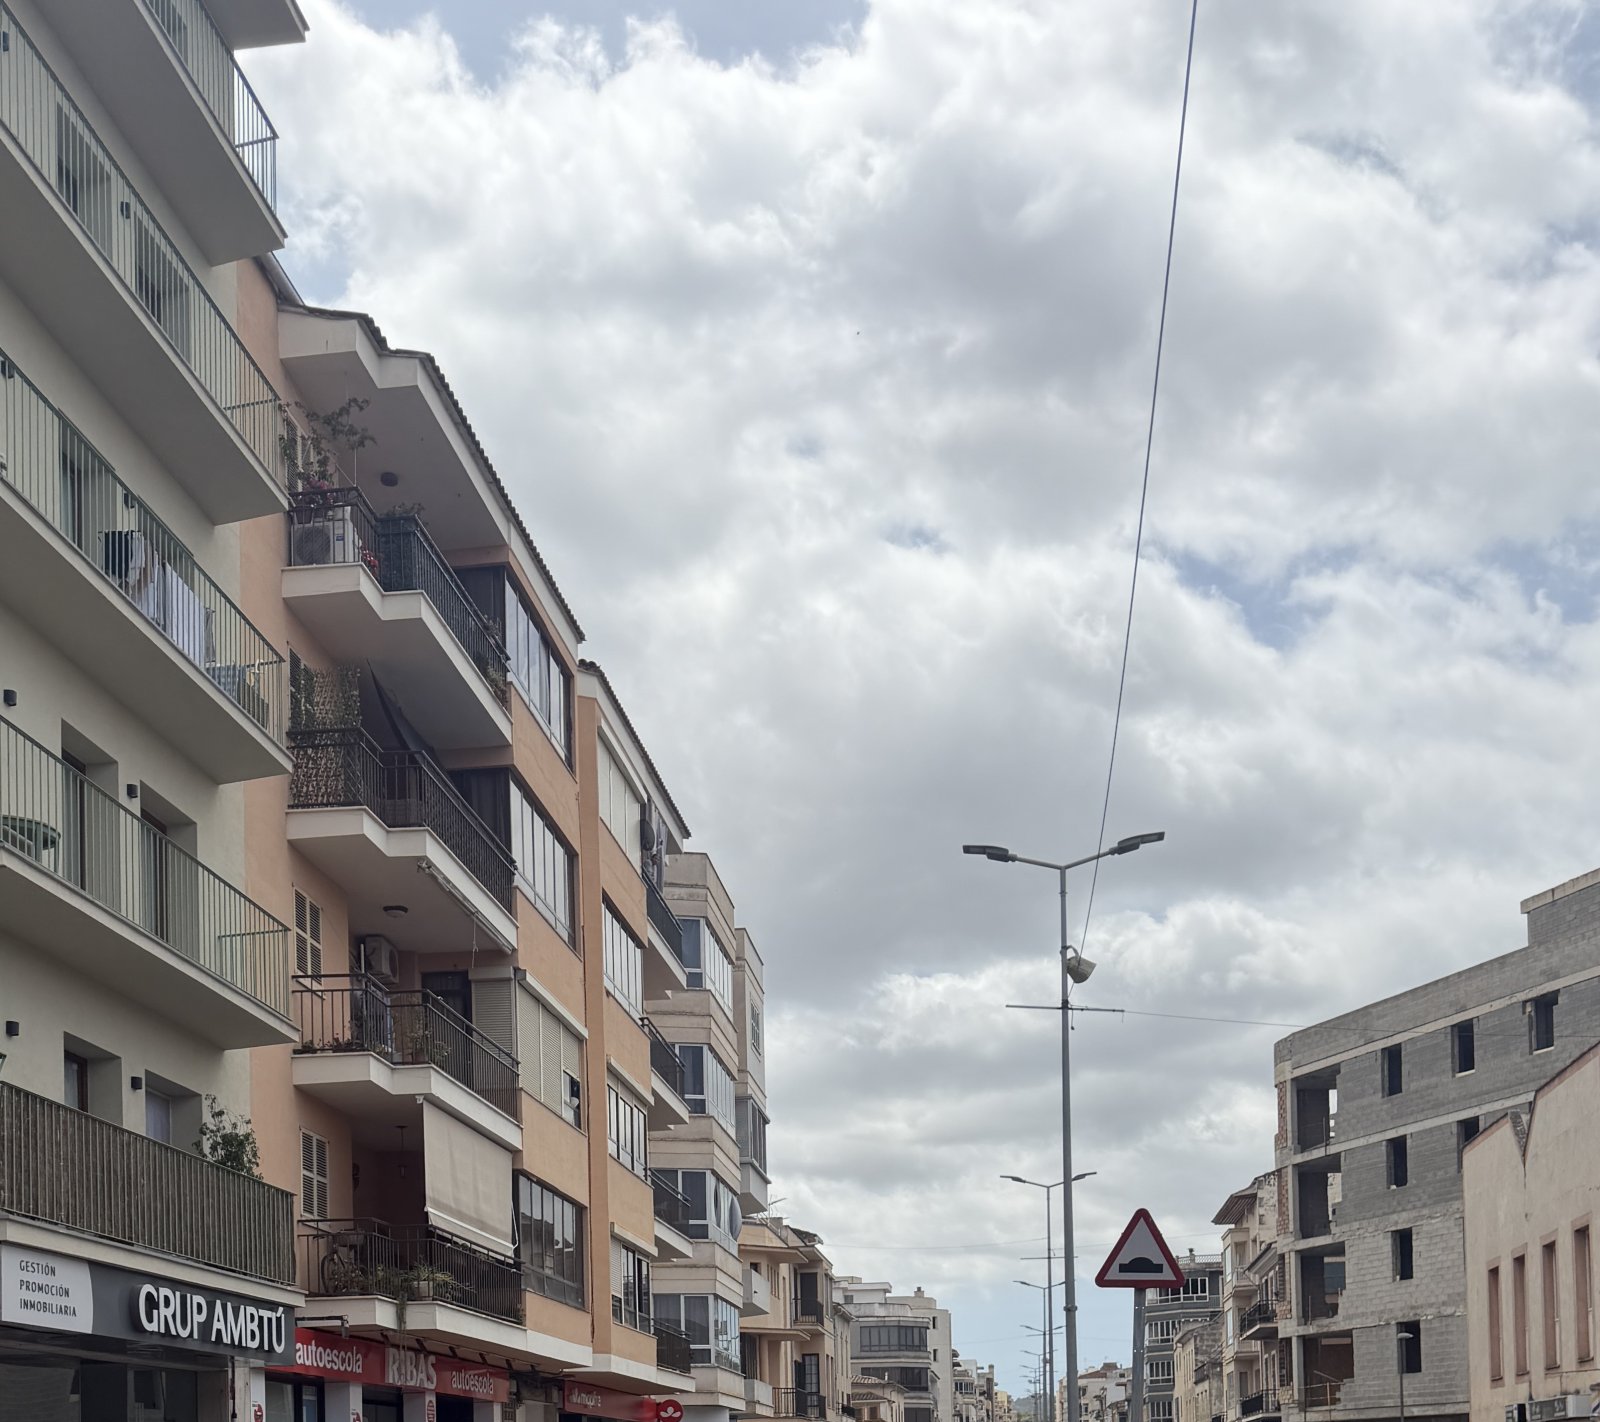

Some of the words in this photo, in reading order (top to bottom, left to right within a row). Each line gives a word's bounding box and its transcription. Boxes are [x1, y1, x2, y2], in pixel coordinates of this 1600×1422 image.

[19, 1259, 56, 1277] GESTIÓN
[19, 1279, 70, 1298] PROMOCIÓN
[19, 1298, 77, 1317] INMOBILIARIA
[138, 1283, 208, 1339] GRUP
[210, 1299, 285, 1354] AMBTÚ
[295, 1340, 363, 1374] autoescola
[384, 1346, 442, 1390] RIBAS
[451, 1369, 495, 1395] autoescola
